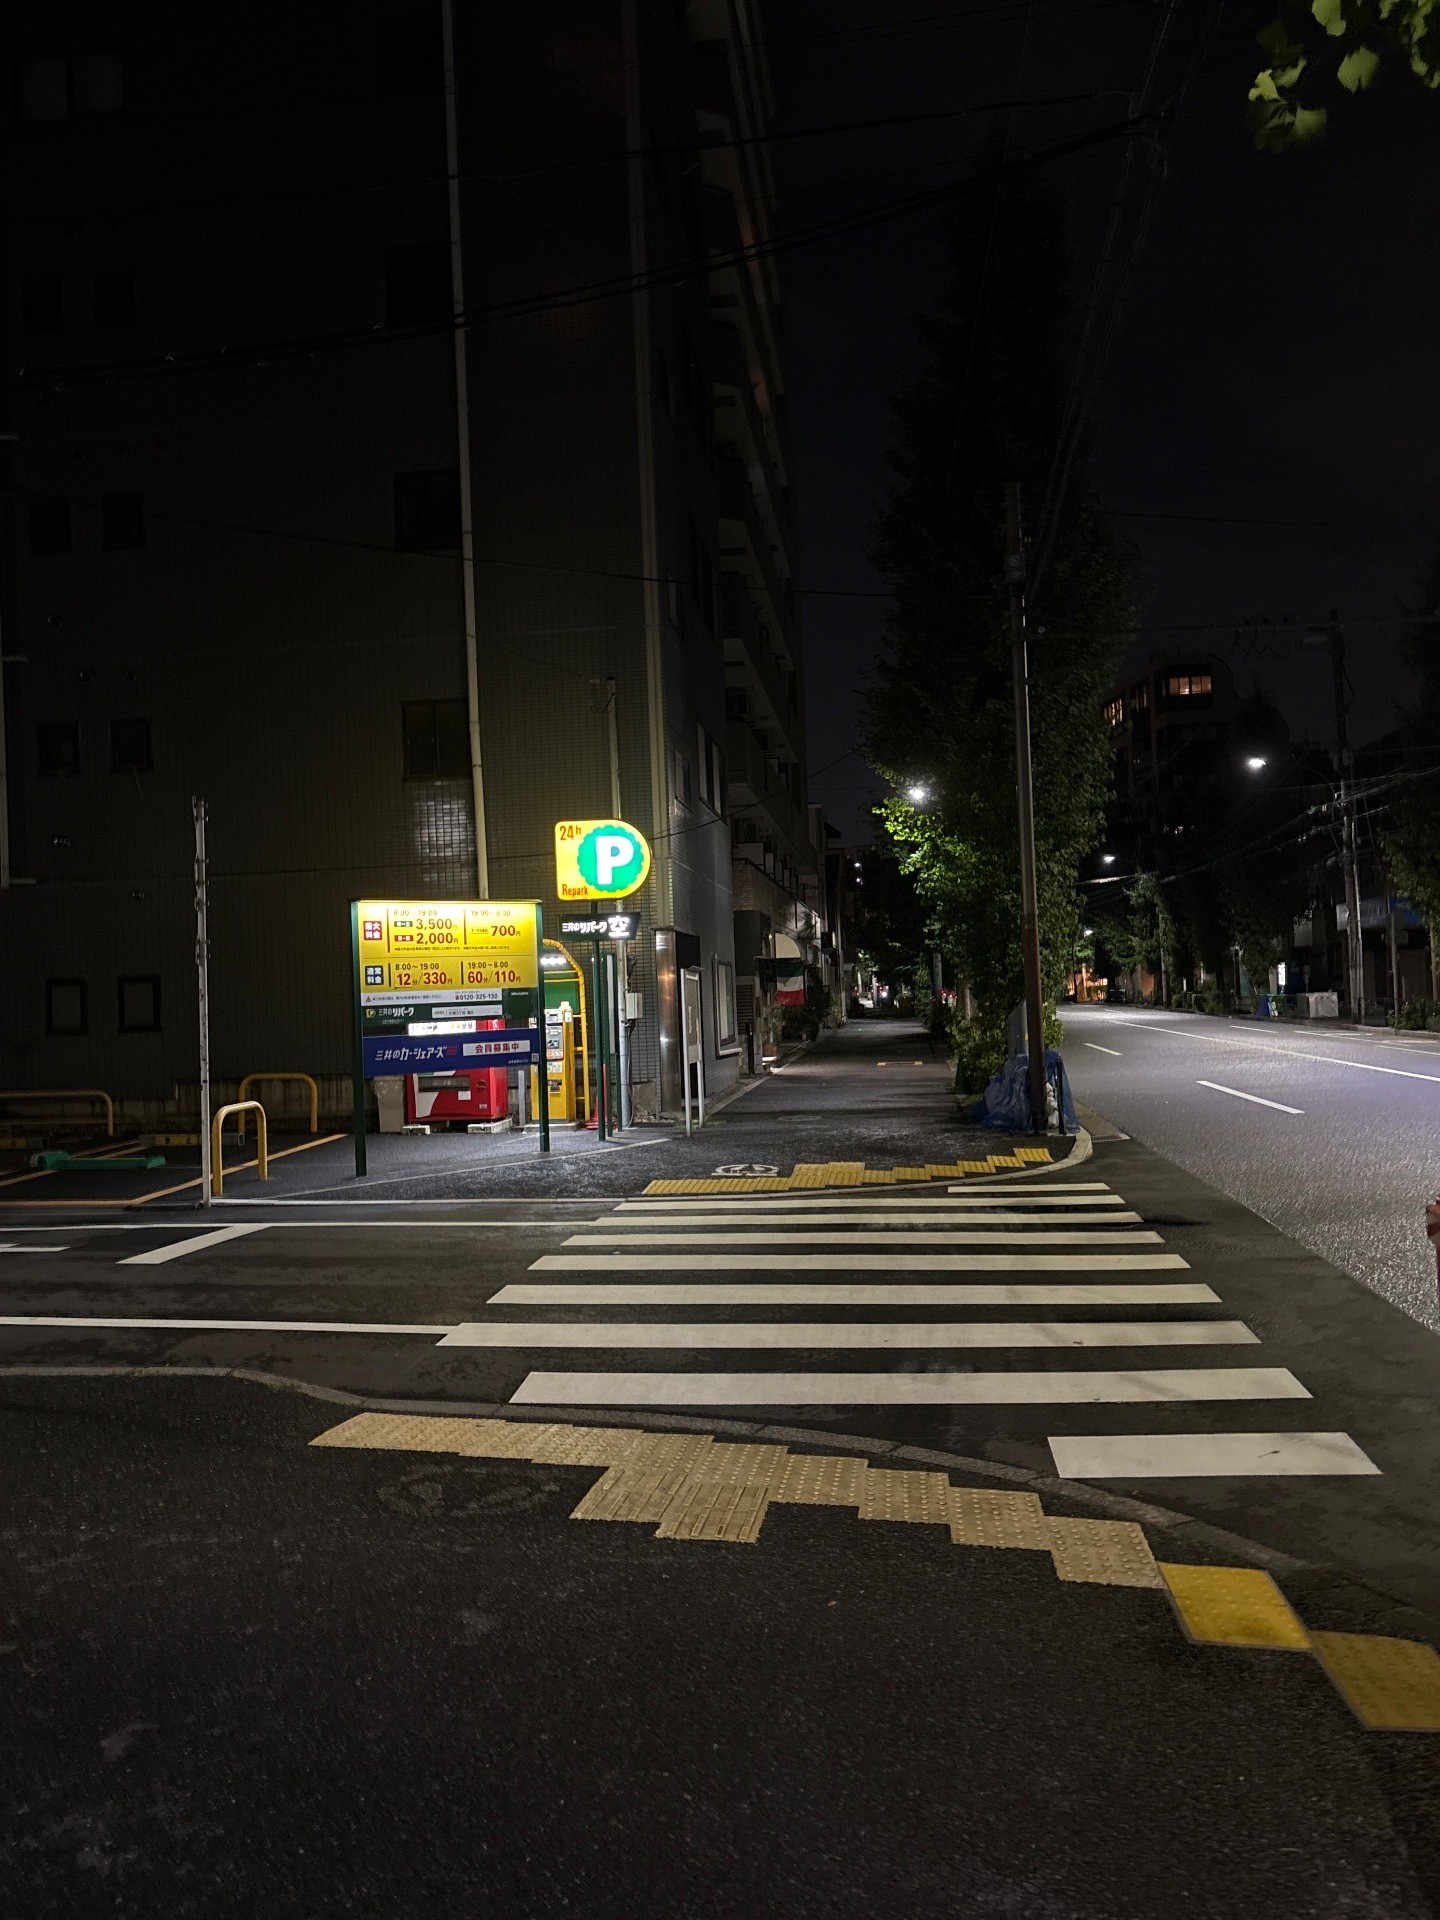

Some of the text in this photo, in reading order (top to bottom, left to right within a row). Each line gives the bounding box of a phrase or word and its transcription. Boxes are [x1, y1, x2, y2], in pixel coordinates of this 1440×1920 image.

[560, 825, 582, 841] 24h
[595, 835, 634, 885] P
[561, 883, 589, 898] Repark
[561, 915, 631, 938] 三井のリパーク 空
[378, 1006, 415, 1018] 三井のリパーク
[475, 1043, 520, 1054] 会員募集中
